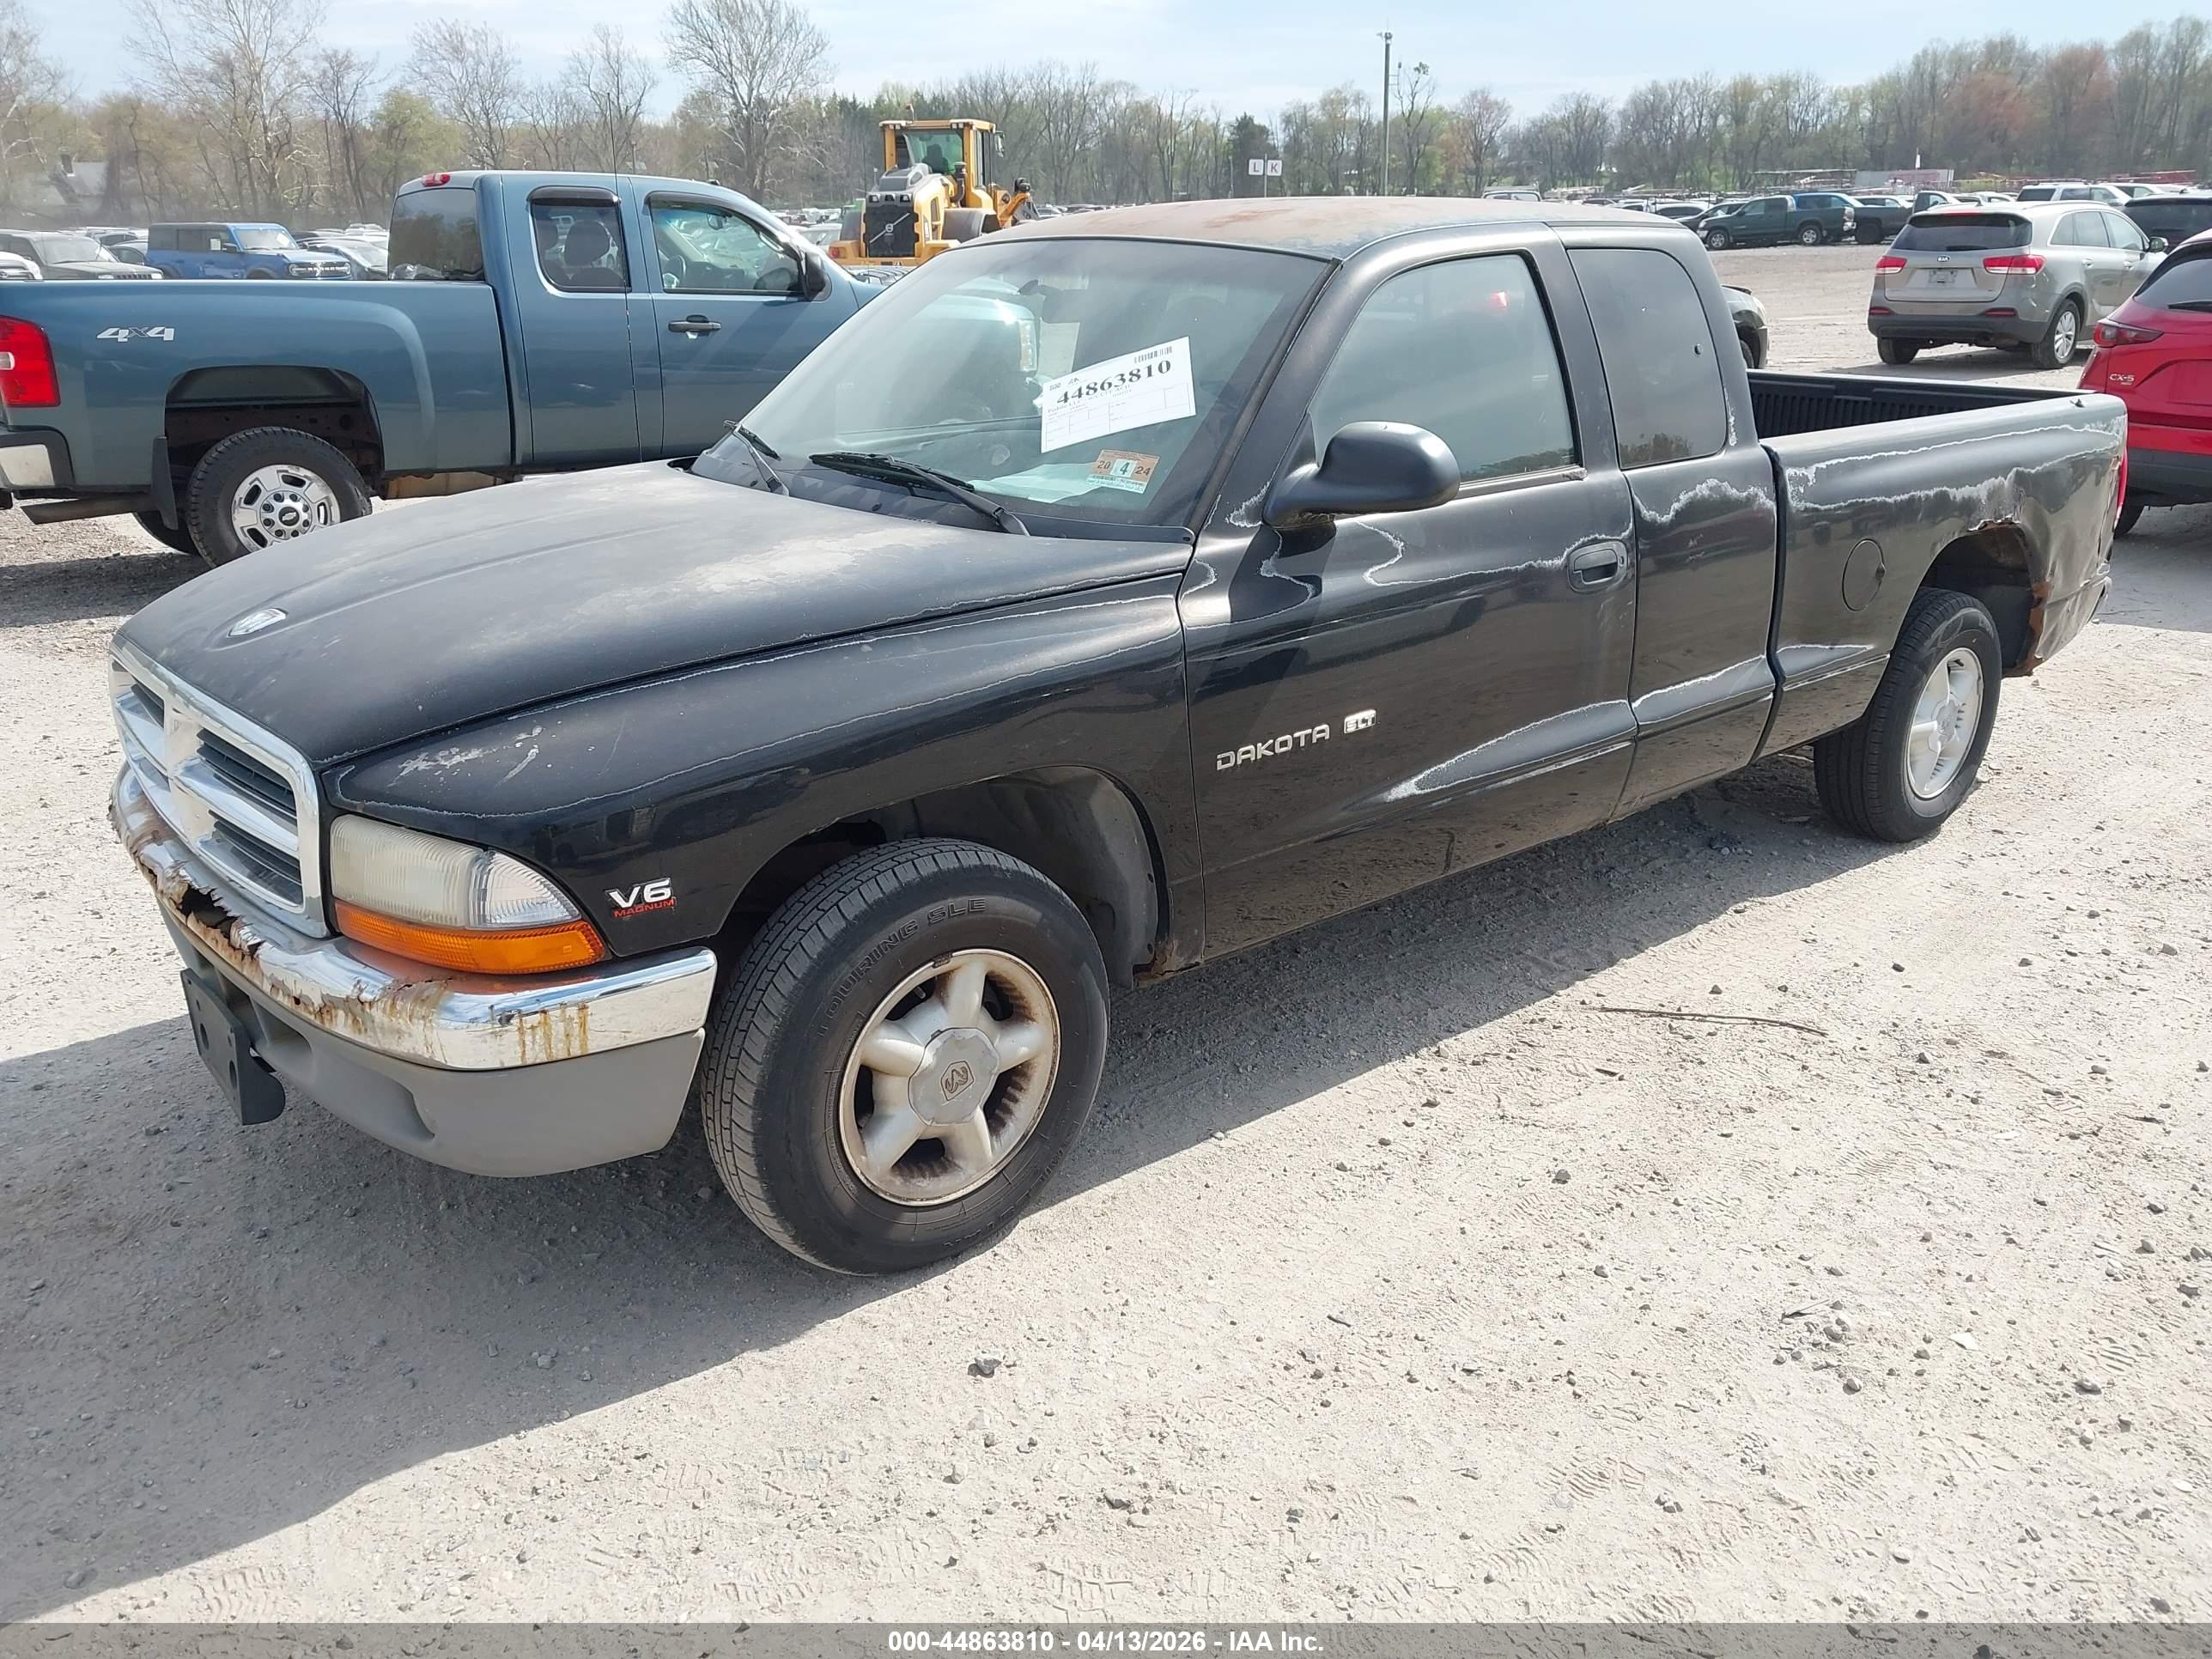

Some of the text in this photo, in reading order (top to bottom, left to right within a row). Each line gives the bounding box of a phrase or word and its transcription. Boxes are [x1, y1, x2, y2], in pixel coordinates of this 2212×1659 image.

[1253, 161, 1260, 173] L
[1270, 163, 1279, 173] K
[1056, 360, 1171, 404] 44863810
[2109, 373, 2135, 382] CX-5
[1097, 460, 1151, 476] 20 4 24
[1216, 711, 1376, 770] DAKOTA SLT
[606, 878, 672, 908] V6
[612, 899, 675, 918] MAGNUM
[927, 897, 987, 925] SLE
